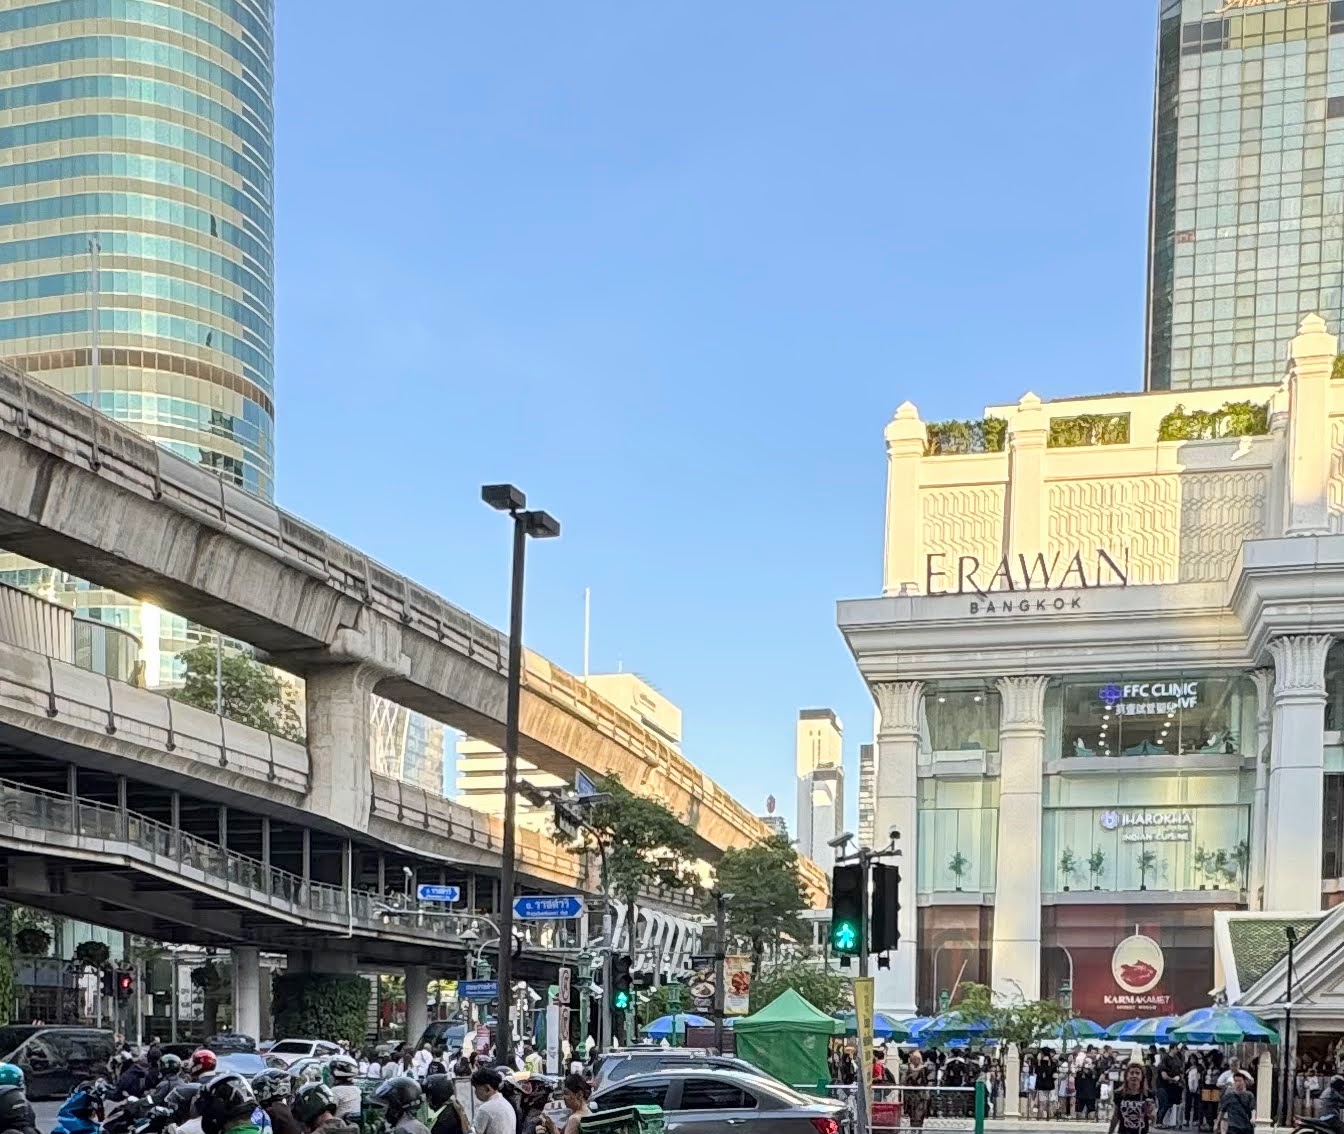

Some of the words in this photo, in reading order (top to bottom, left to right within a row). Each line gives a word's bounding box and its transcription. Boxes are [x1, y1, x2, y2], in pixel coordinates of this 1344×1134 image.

[926, 547, 1129, 598] ERAWAN
[969, 596, 1082, 615] BANGKOK
[1123, 684, 1150, 698] FFC
[1151, 682, 1198, 698] CLINIC
[1177, 696, 1198, 709] IVF
[1104, 995, 1171, 1005] KARMAKAMET
